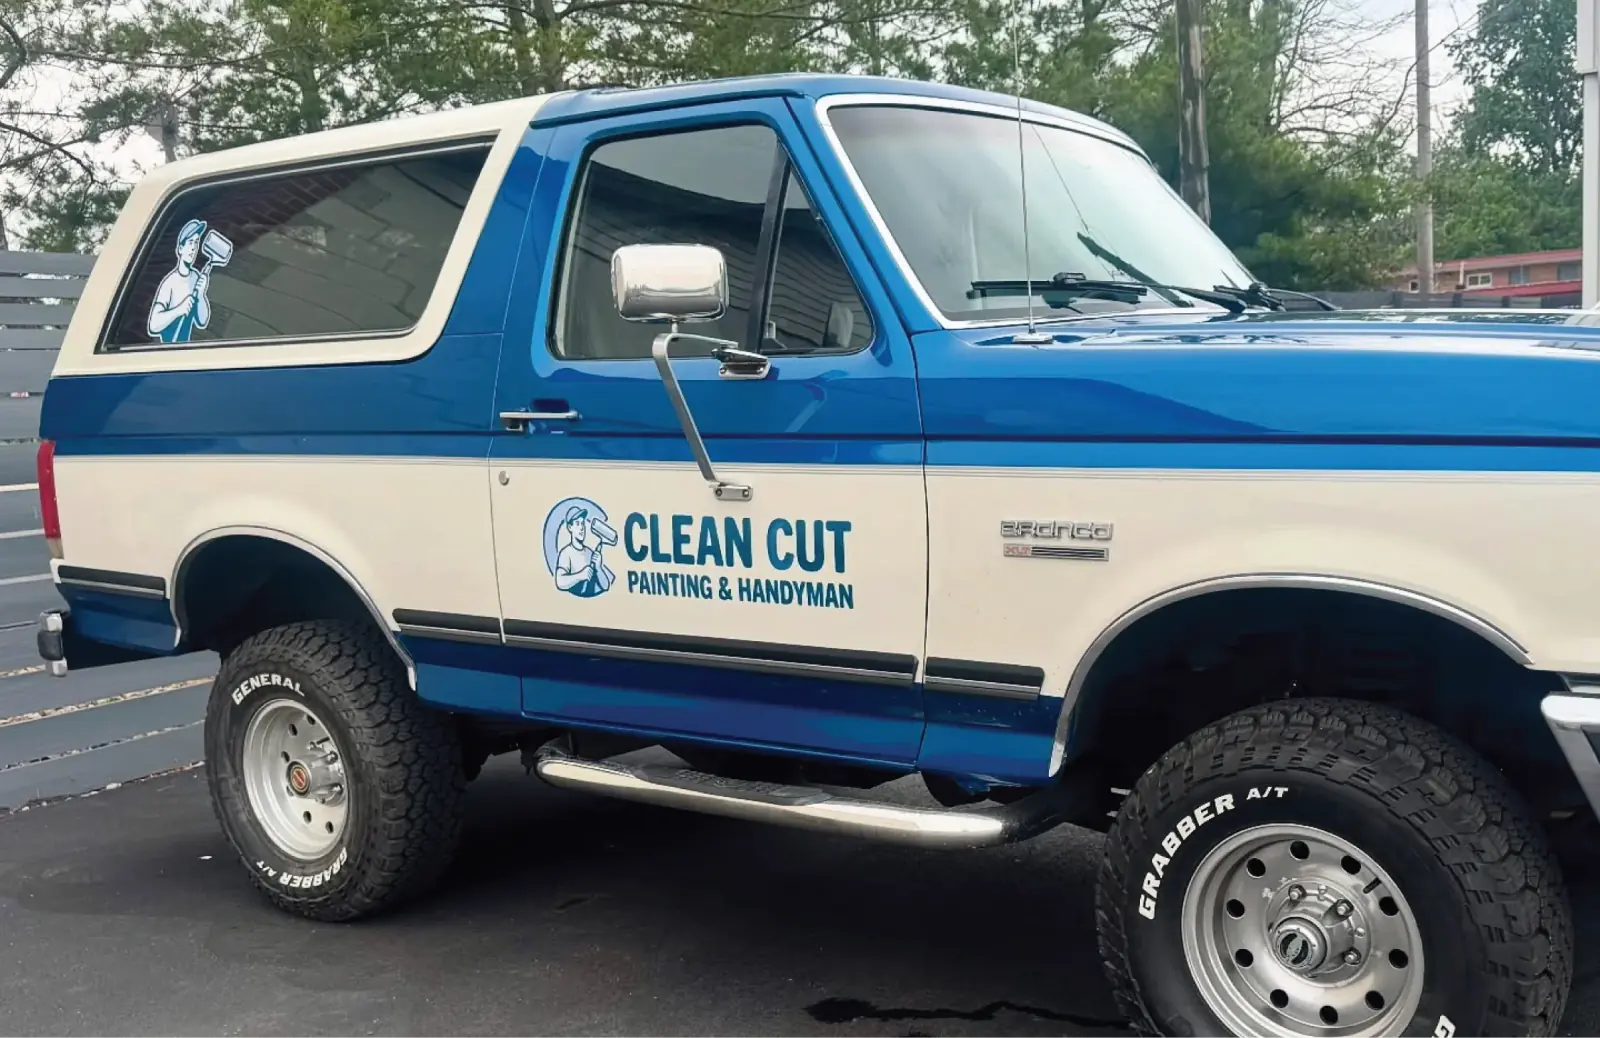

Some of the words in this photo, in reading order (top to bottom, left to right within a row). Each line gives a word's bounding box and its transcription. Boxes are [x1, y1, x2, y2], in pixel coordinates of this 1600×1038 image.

[623, 511, 753, 568] CLEAN
[766, 517, 852, 574] CUT
[627, 570, 713, 600] PAINTING
[718, 576, 733, 601] &
[737, 577, 854, 610] HANDYMAN
[231, 672, 305, 706] GENERAL
[256, 860, 277, 877] A/T
[279, 846, 348, 889] GRABBER
[1138, 793, 1236, 920] GRABBER
[1246, 786, 1289, 801] A/T
